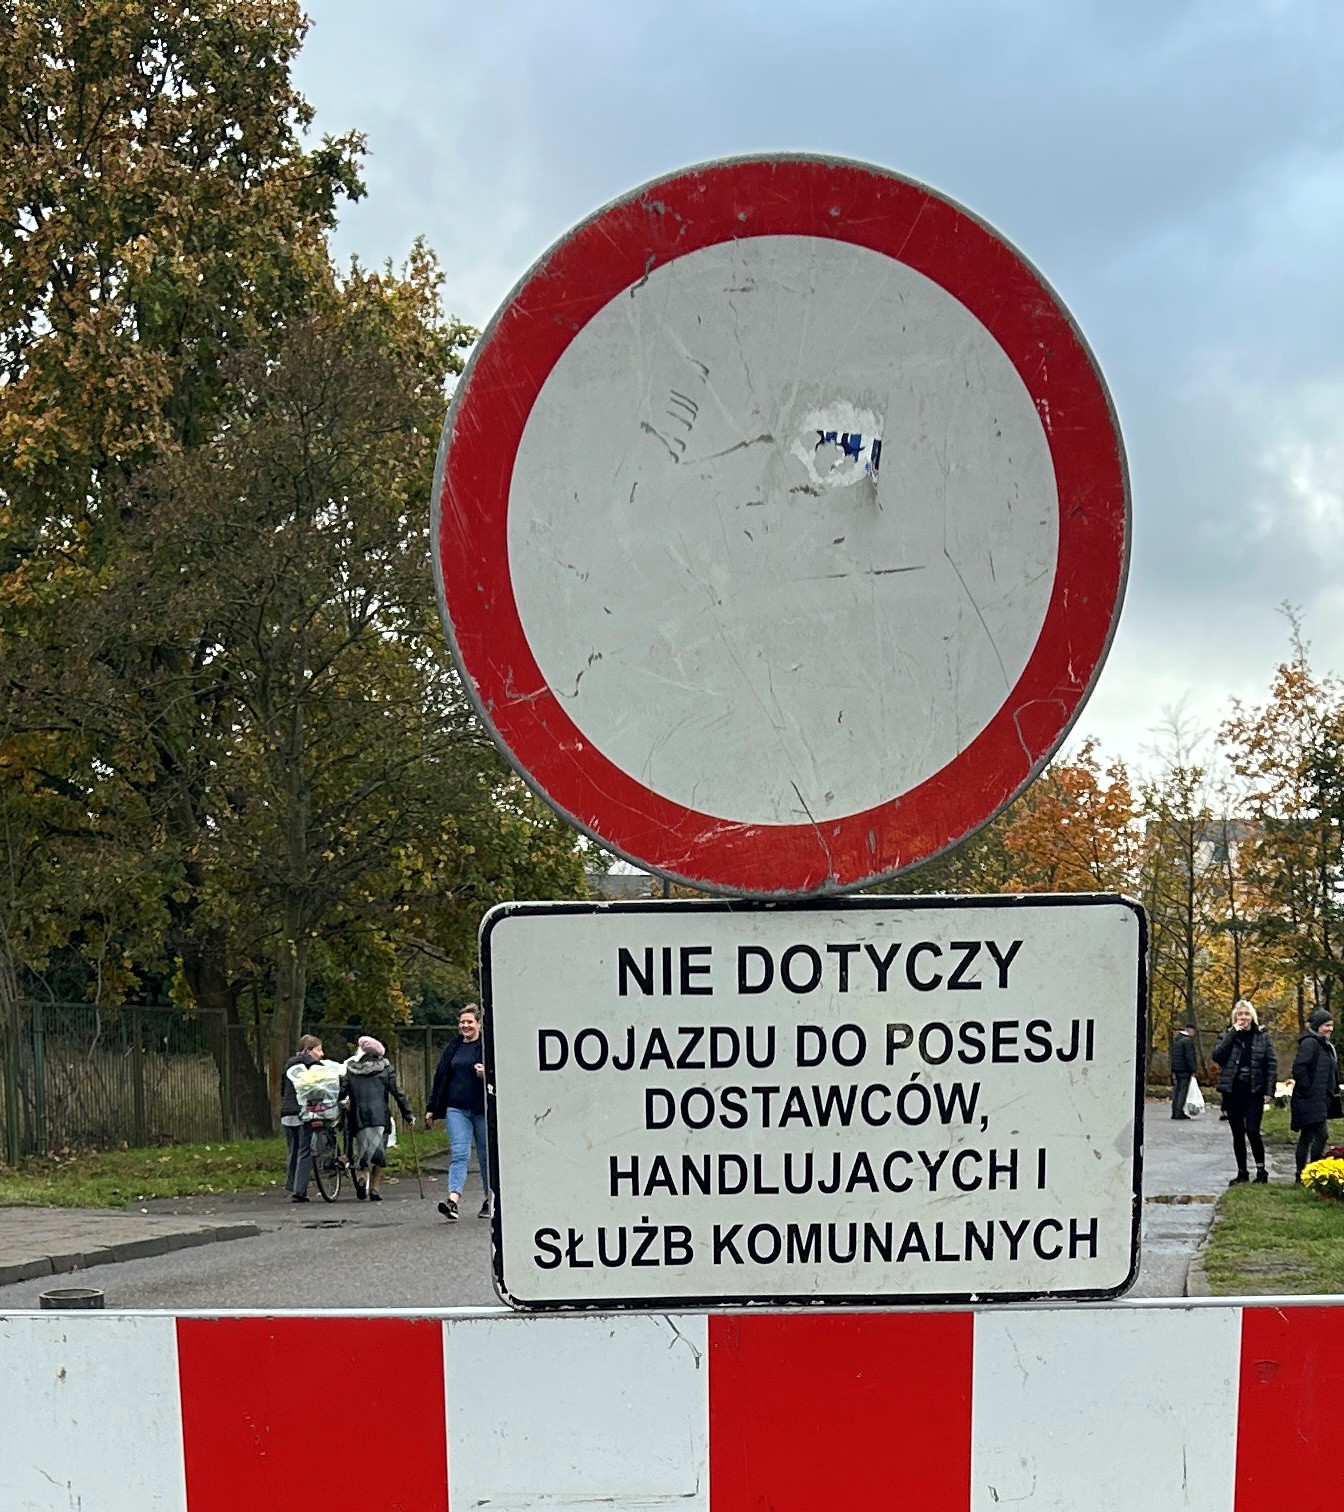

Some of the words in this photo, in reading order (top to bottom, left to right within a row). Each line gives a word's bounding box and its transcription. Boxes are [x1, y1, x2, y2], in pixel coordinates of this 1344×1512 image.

[617, 945, 714, 997] NIE
[737, 940, 1024, 995] DOTYCZY
[538, 1025, 776, 1072] DOJAZDU
[796, 1023, 867, 1068] DO
[885, 1018, 1095, 1066] POSESJI
[645, 1072, 989, 1133] DOSTAWCÓW,
[609, 1148, 1018, 1197] HANDLUJACYCH
[1037, 1147, 1046, 1190] I
[533, 1215, 694, 1270] SŁUŻB
[712, 1217, 1098, 1265] KOMUNALNYCH
